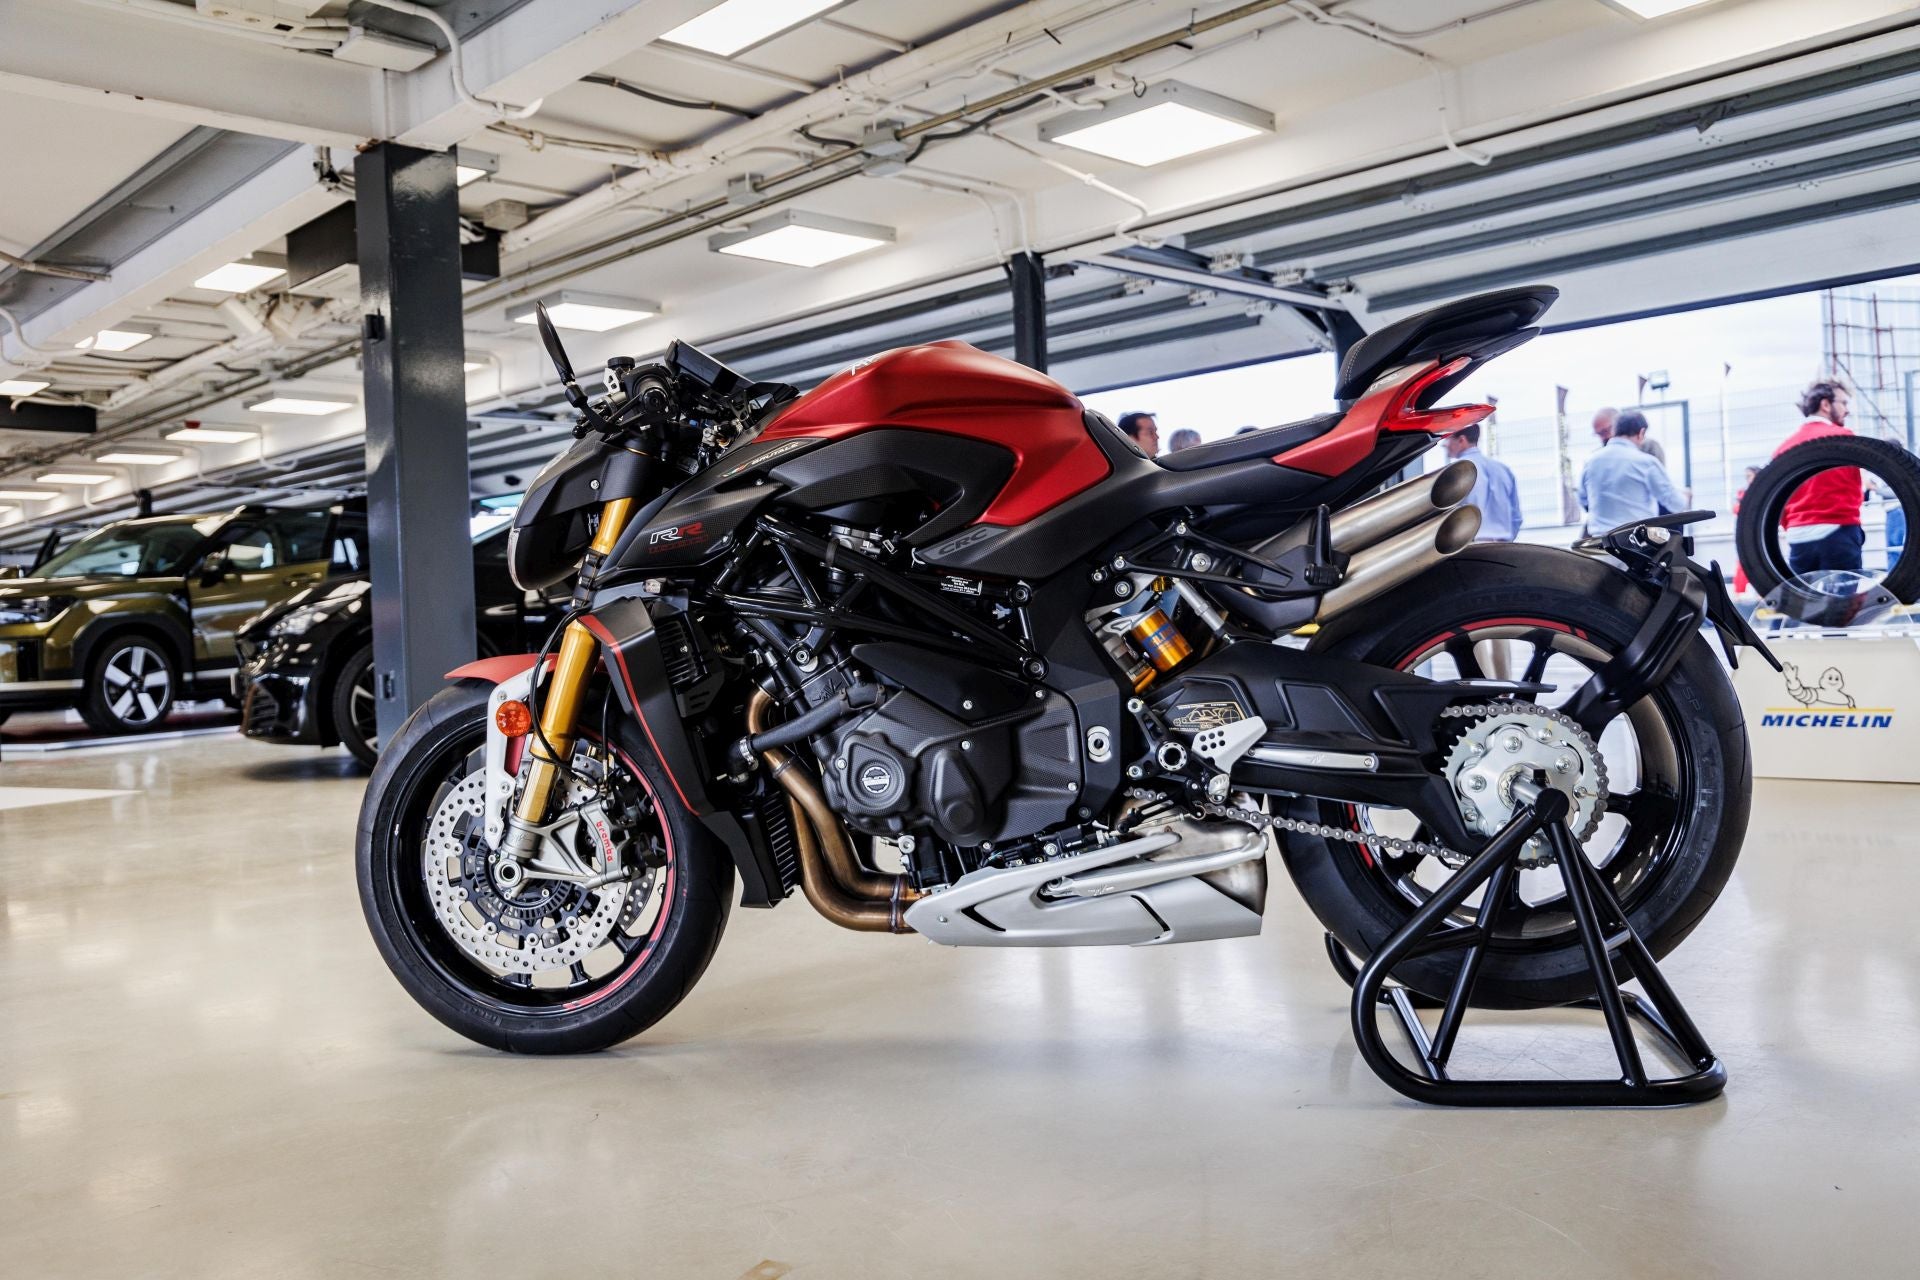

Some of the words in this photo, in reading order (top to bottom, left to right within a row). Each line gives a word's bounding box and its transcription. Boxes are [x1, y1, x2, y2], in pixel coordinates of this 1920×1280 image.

[938, 528, 988, 556] CRC
[1761, 714, 1893, 728] MICHELIN
[596, 820, 614, 862] brembo
